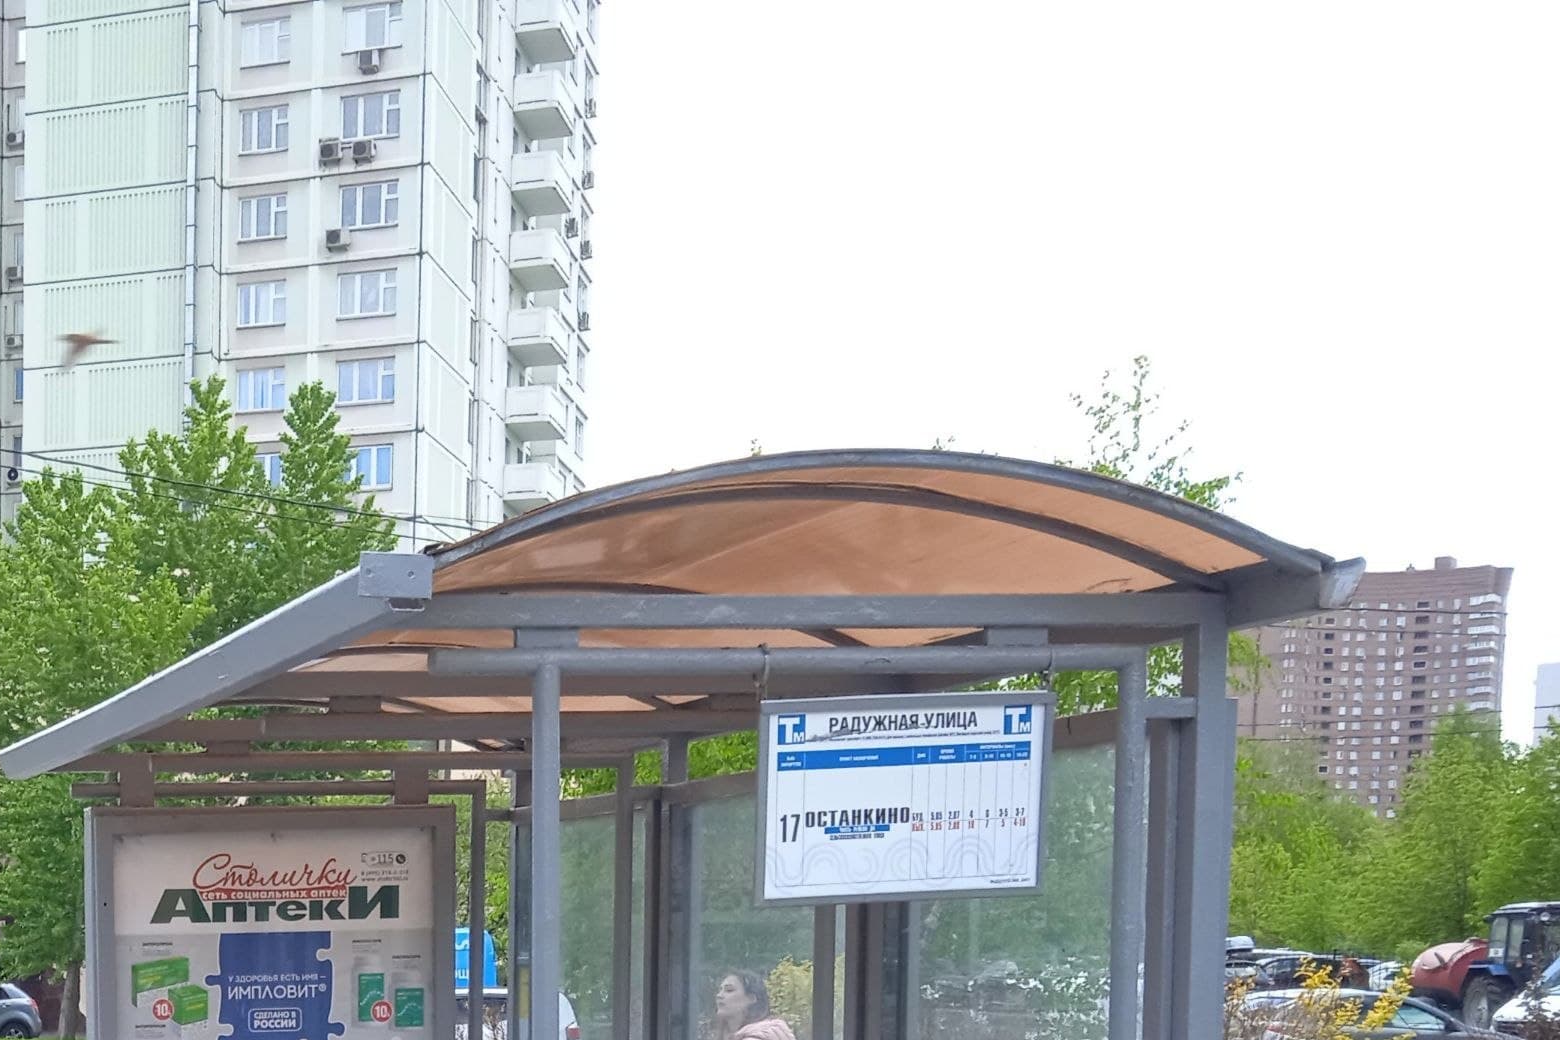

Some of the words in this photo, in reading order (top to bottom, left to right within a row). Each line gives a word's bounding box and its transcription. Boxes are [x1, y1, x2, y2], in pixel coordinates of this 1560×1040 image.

[829, 713, 919, 734] РАДУЖНАЯ
[925, 711, 978, 730] УЛИЦА
[780, 814, 801, 843] 17
[805, 807, 910, 828] ОСТАНКИНО
[192, 853, 358, 889] Столички
[202, 891, 228, 900] сеть
[230, 890, 308, 901] социальных
[310, 888, 347, 898] аптек
[235, 975, 279, 983] ЗДОРОВЬЯ
[280, 973, 300, 981] ЕСТЬ
[301, 973, 318, 981] ИМЯ
[254, 1011, 290, 1020] СДЕЛАНО
[291, 1010, 297, 1018] В
[253, 1019, 297, 1029] РОССИИ
